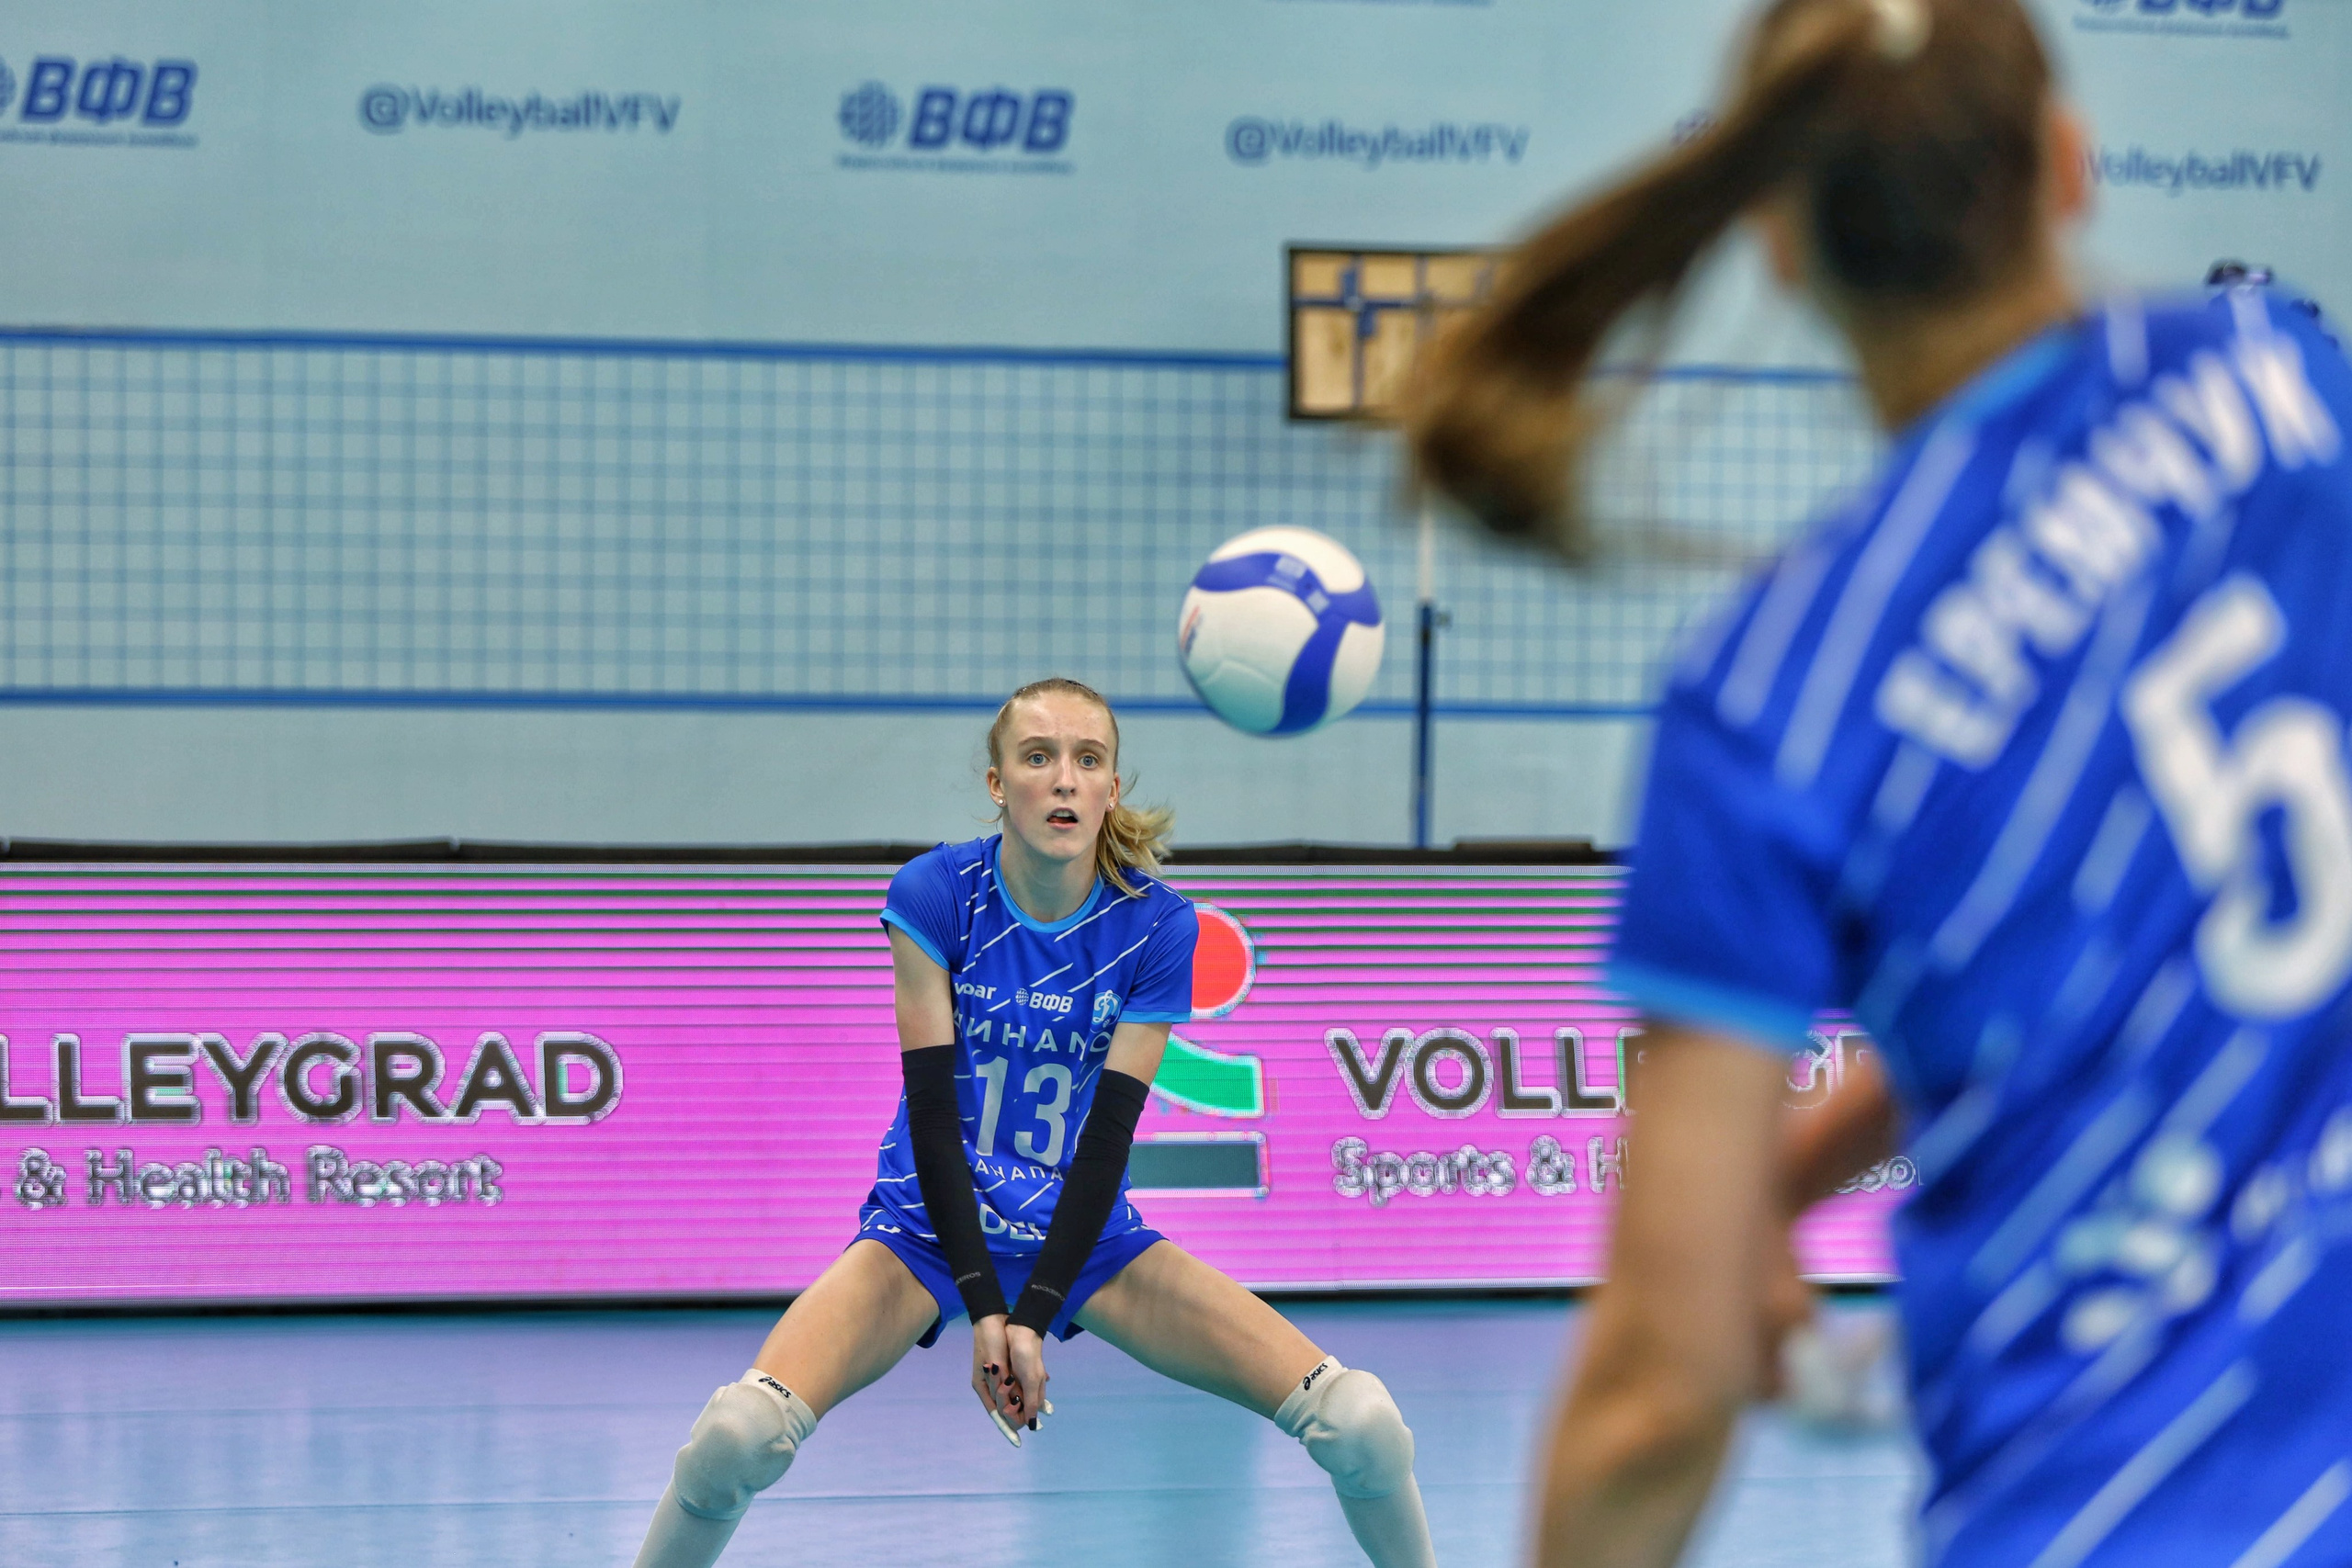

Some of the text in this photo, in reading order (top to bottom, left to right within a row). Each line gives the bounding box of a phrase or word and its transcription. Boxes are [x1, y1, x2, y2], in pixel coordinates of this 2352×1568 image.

[20, 55, 198, 127] ВФВ
[358, 84, 682, 140] @VolleyballVFV
[909, 85, 1075, 152] ВФВ
[1225, 116, 1531, 172] @VolleyballVFV
[2080, 143, 2322, 198] VolleyballVFV
[2120, 570, 2352, 1023] 5
[1028, 991, 1074, 1013] ВФВ
[975, 1055, 1074, 1167] 13
[17, 1145, 504, 1209] & Health Resort
[1330, 1136, 1516, 1207] Sports
[1525, 1135, 1577, 1196] &
[979, 1202, 1047, 1241] DEL
